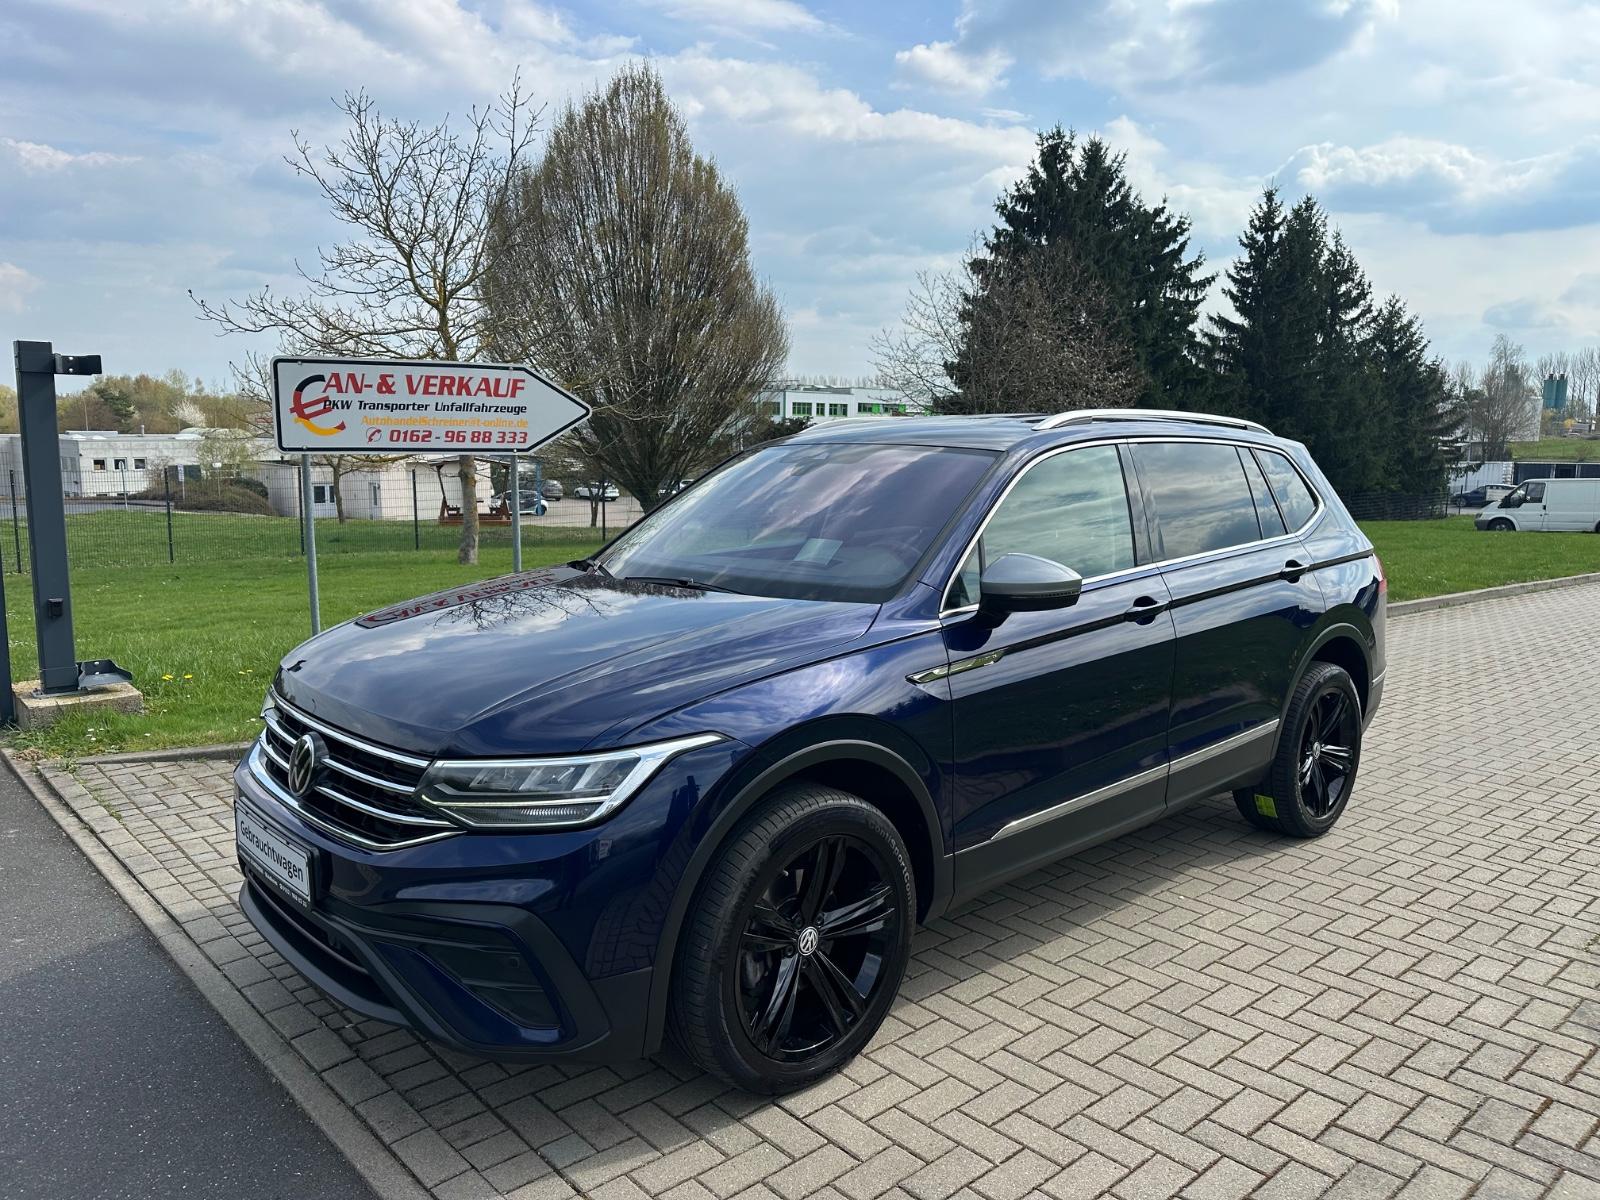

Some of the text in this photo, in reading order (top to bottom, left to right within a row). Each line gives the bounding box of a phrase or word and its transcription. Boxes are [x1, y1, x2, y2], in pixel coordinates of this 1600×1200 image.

[405, 375, 525, 398] VERKAUF
[323, 399, 527, 416] PKW Transporter Unfallfahrzeuge
[389, 429, 432, 443] 0162
[444, 430, 467, 443] 96
[470, 430, 493, 444] 88
[496, 431, 528, 444] 333
[240, 820, 304, 882] Gebrauchtwagen
